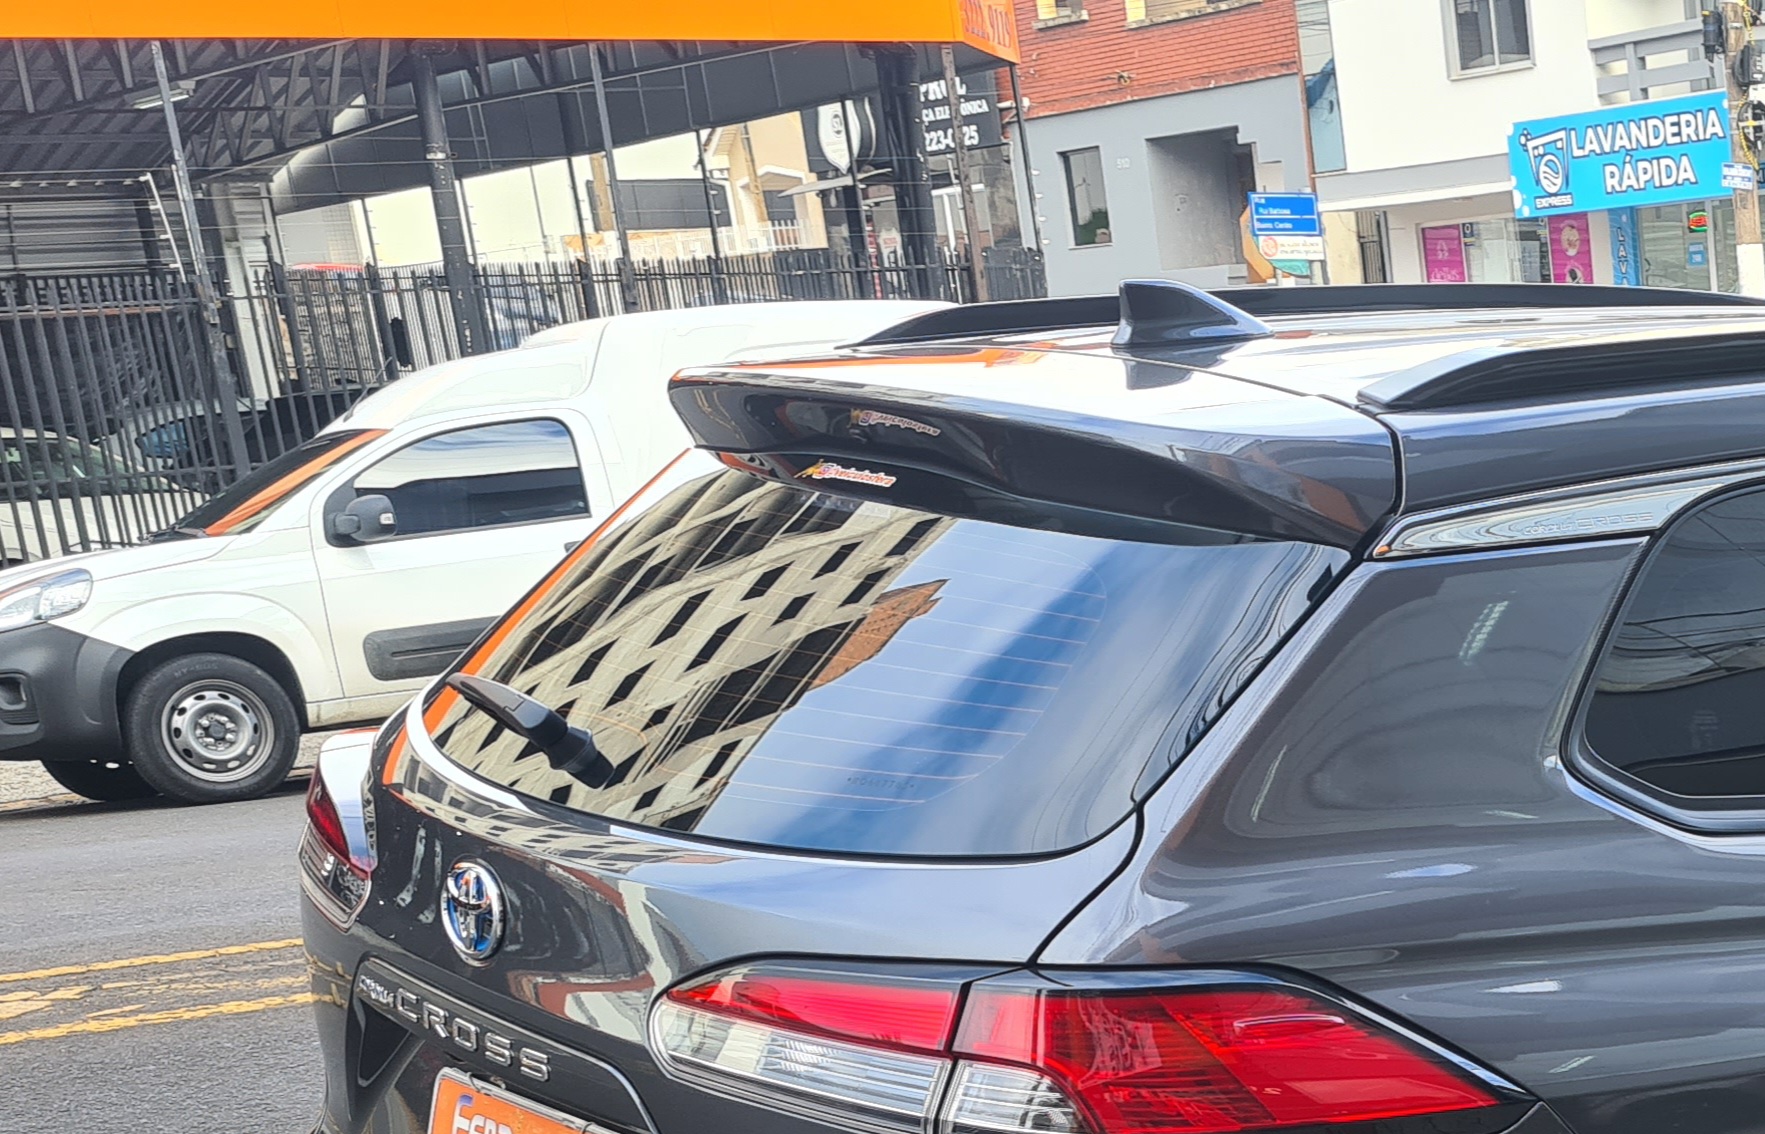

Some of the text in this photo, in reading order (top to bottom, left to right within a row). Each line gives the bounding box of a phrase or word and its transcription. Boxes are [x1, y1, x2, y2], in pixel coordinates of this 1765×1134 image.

[1570, 107, 1726, 158] LAVANDERIA
[1604, 153, 1698, 194] RÁPIDA
[1535, 194, 1573, 209] EXPRESS
[397, 987, 551, 1082] CROSS
